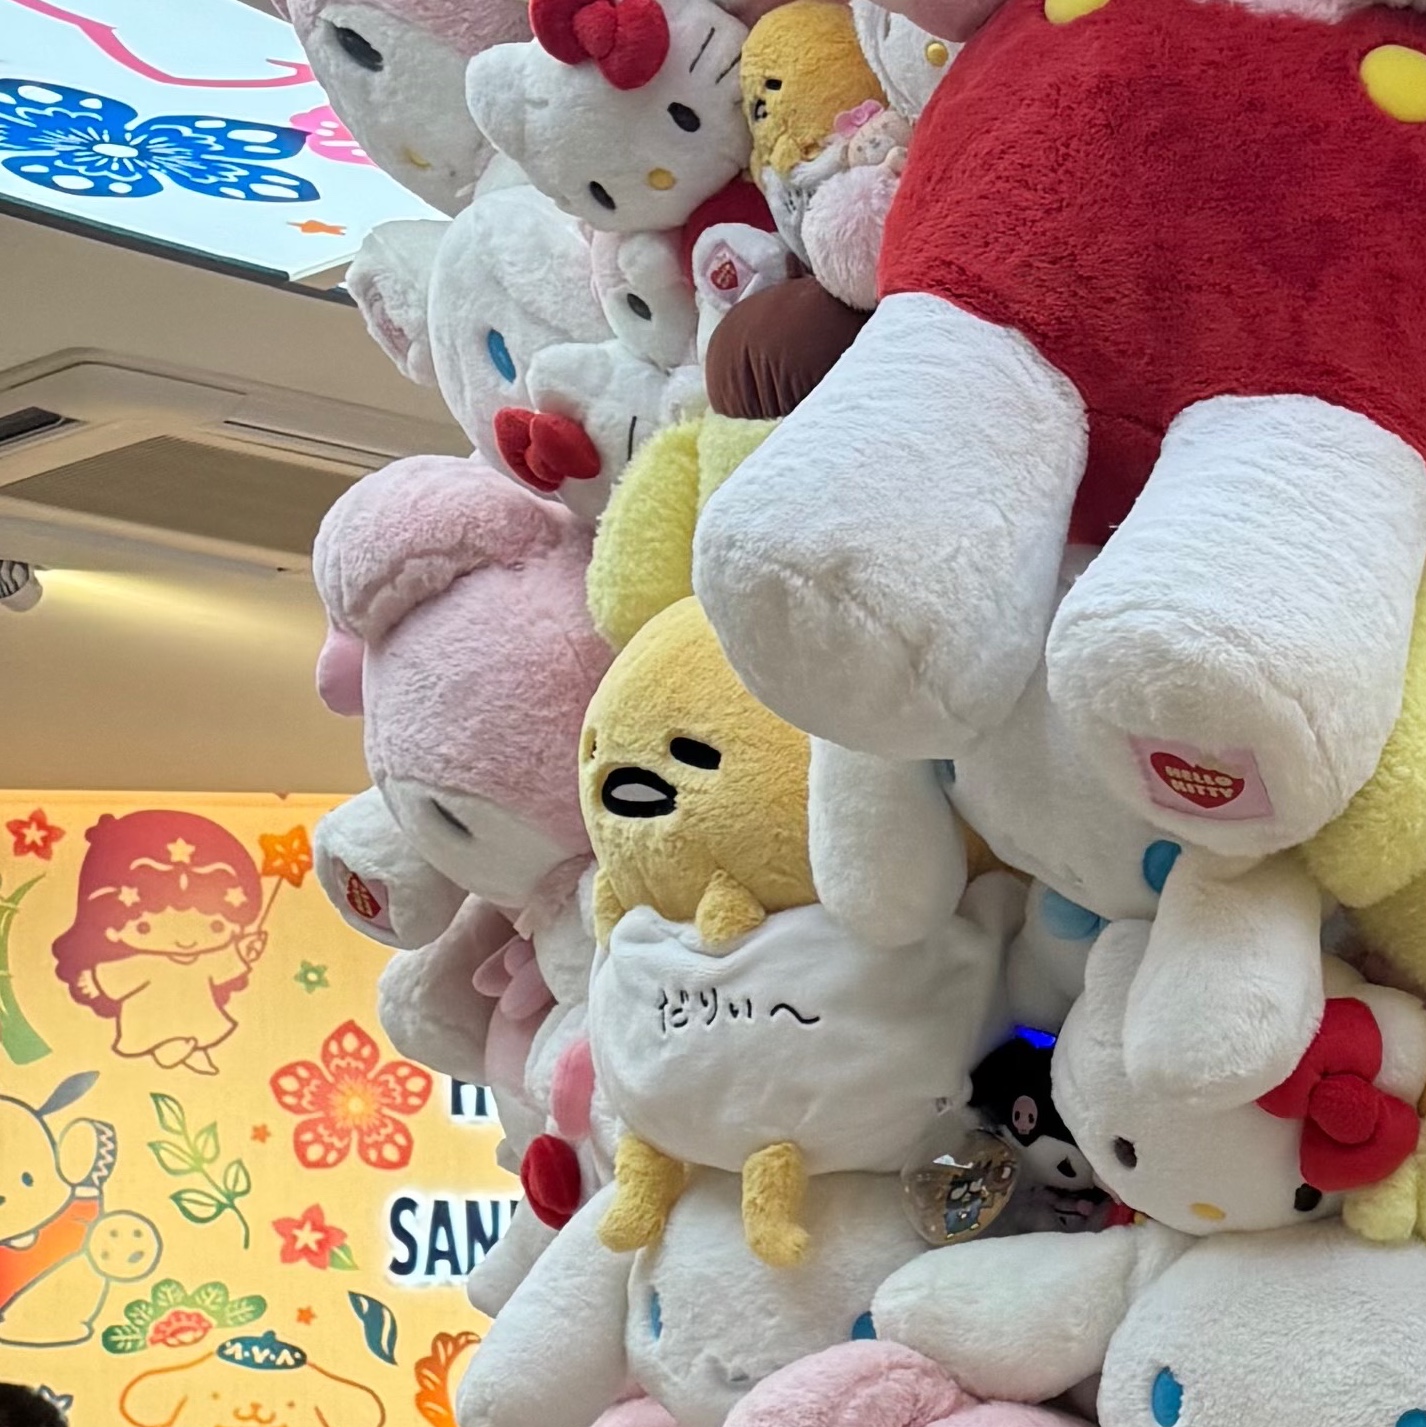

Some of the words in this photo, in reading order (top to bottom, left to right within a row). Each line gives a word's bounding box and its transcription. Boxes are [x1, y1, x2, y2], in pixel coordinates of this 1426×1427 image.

[1165, 765, 1234, 787] HELLO
[1170, 779, 1235, 799] KITTY
[389, 1196, 519, 1276] SAN
